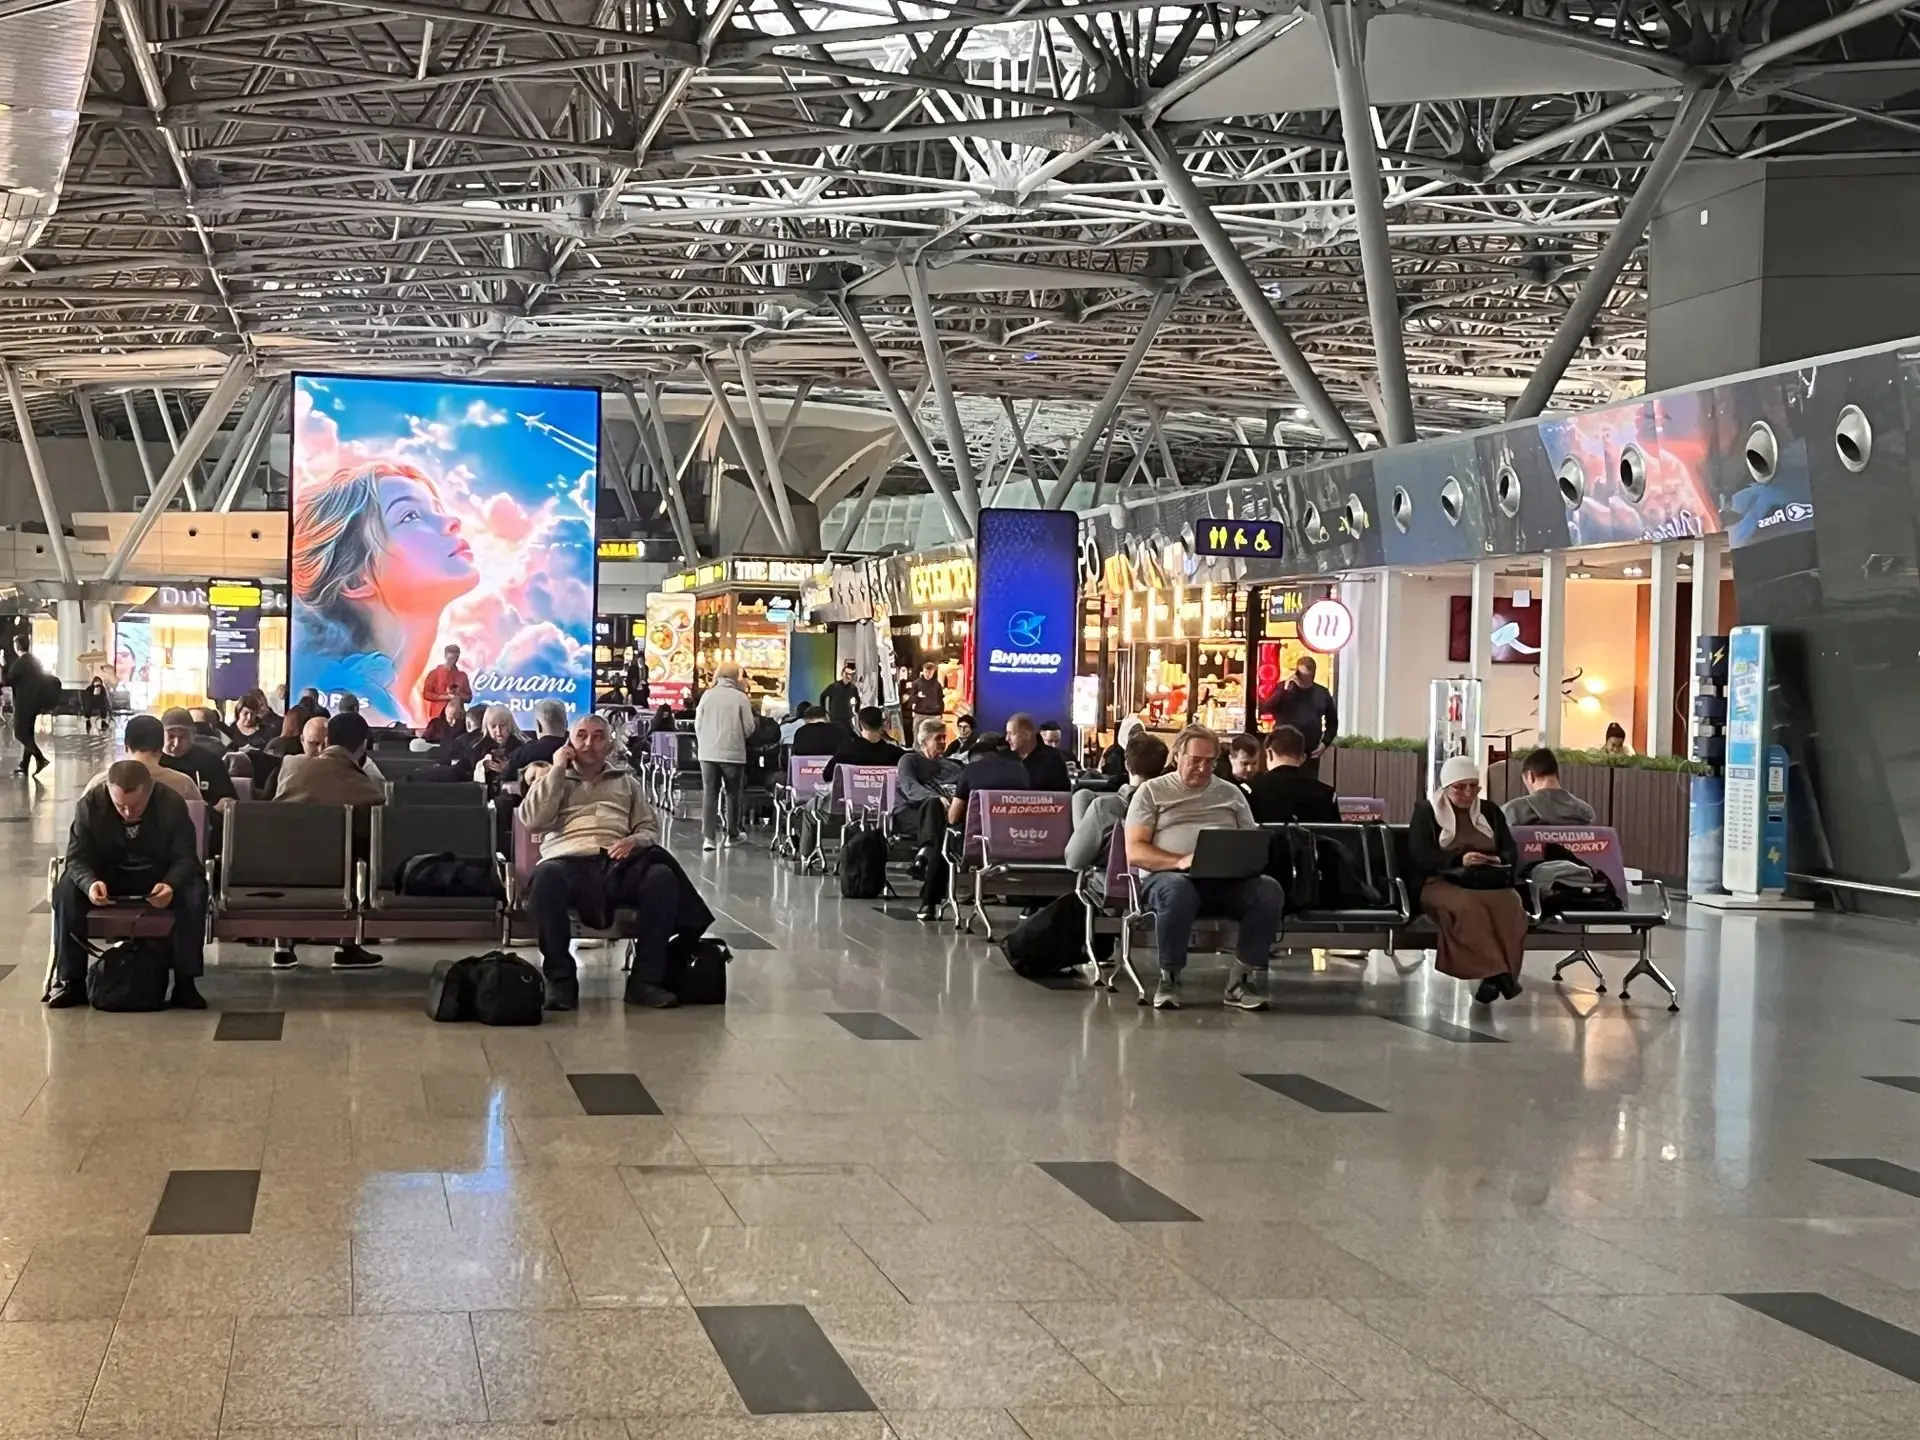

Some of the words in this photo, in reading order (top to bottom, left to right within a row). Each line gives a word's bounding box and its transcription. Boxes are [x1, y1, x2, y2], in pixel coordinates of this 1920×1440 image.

[990, 649, 1062, 667] Внуково
[1001, 795, 1054, 805] ПОСИДИМ
[991, 804, 1007, 815] НА
[1007, 805, 1065, 815] ДОРОЖКУ
[1009, 827, 1049, 839] tutu
[1534, 831, 1595, 841] ПОСИДИМ
[1524, 842, 1543, 853] НА
